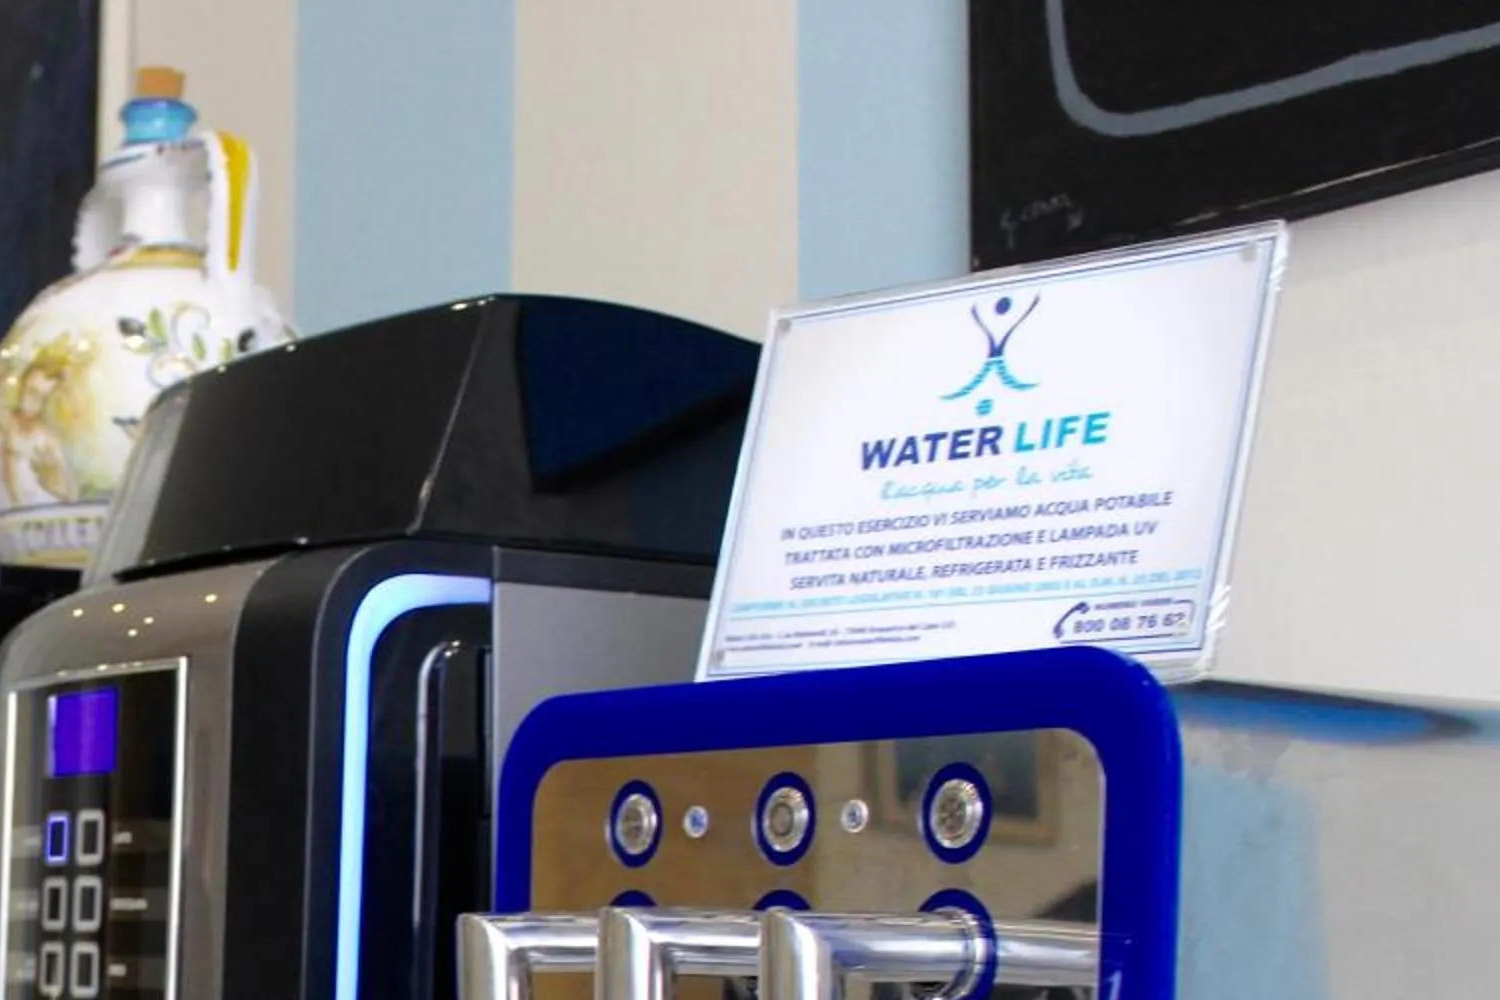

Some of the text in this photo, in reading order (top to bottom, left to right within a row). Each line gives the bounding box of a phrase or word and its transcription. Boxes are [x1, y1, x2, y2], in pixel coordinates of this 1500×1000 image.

[861, 411, 1111, 470] WATER LIFE
[780, 491, 1174, 541] IN QUESTO ESERCIZIO VI SERVIAMO ACQUA POTABILE
[784, 520, 1160, 565] TRATTATA CON MICROFILTRAZIONE E LAMPADA UV
[789, 572, 845, 591] SERVITA
[930, 557, 1033, 578] REFRIGERATA
[1036, 556, 1047, 571] E
[1050, 549, 1140, 570] FRIZZANTE
